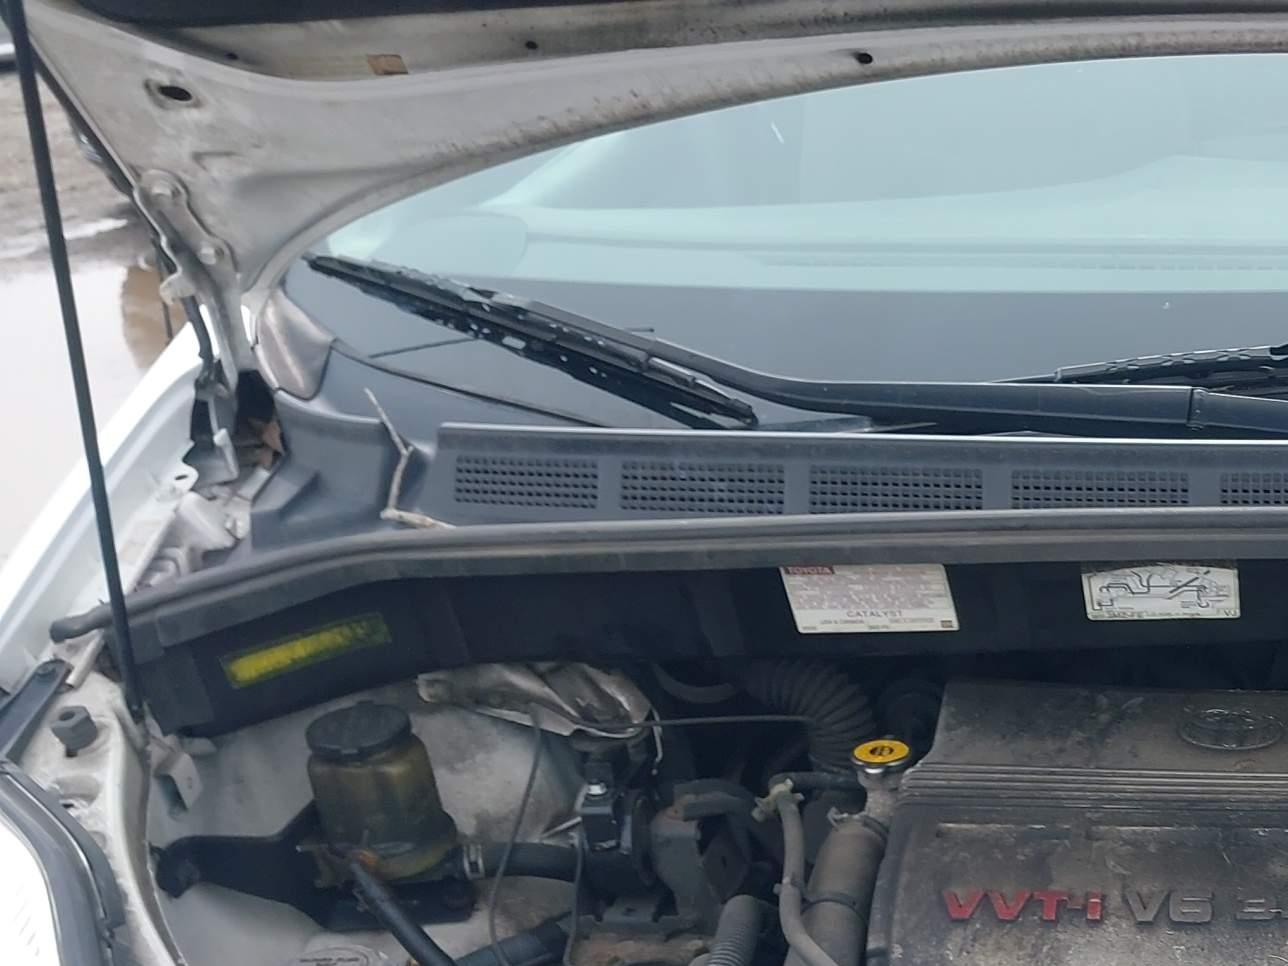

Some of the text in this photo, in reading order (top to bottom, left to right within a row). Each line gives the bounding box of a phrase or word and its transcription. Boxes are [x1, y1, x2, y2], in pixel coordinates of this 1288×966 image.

[786, 566, 832, 576] TOYOTA
[846, 610, 904, 619] CATALYST
[1126, 890, 1215, 923] V6
